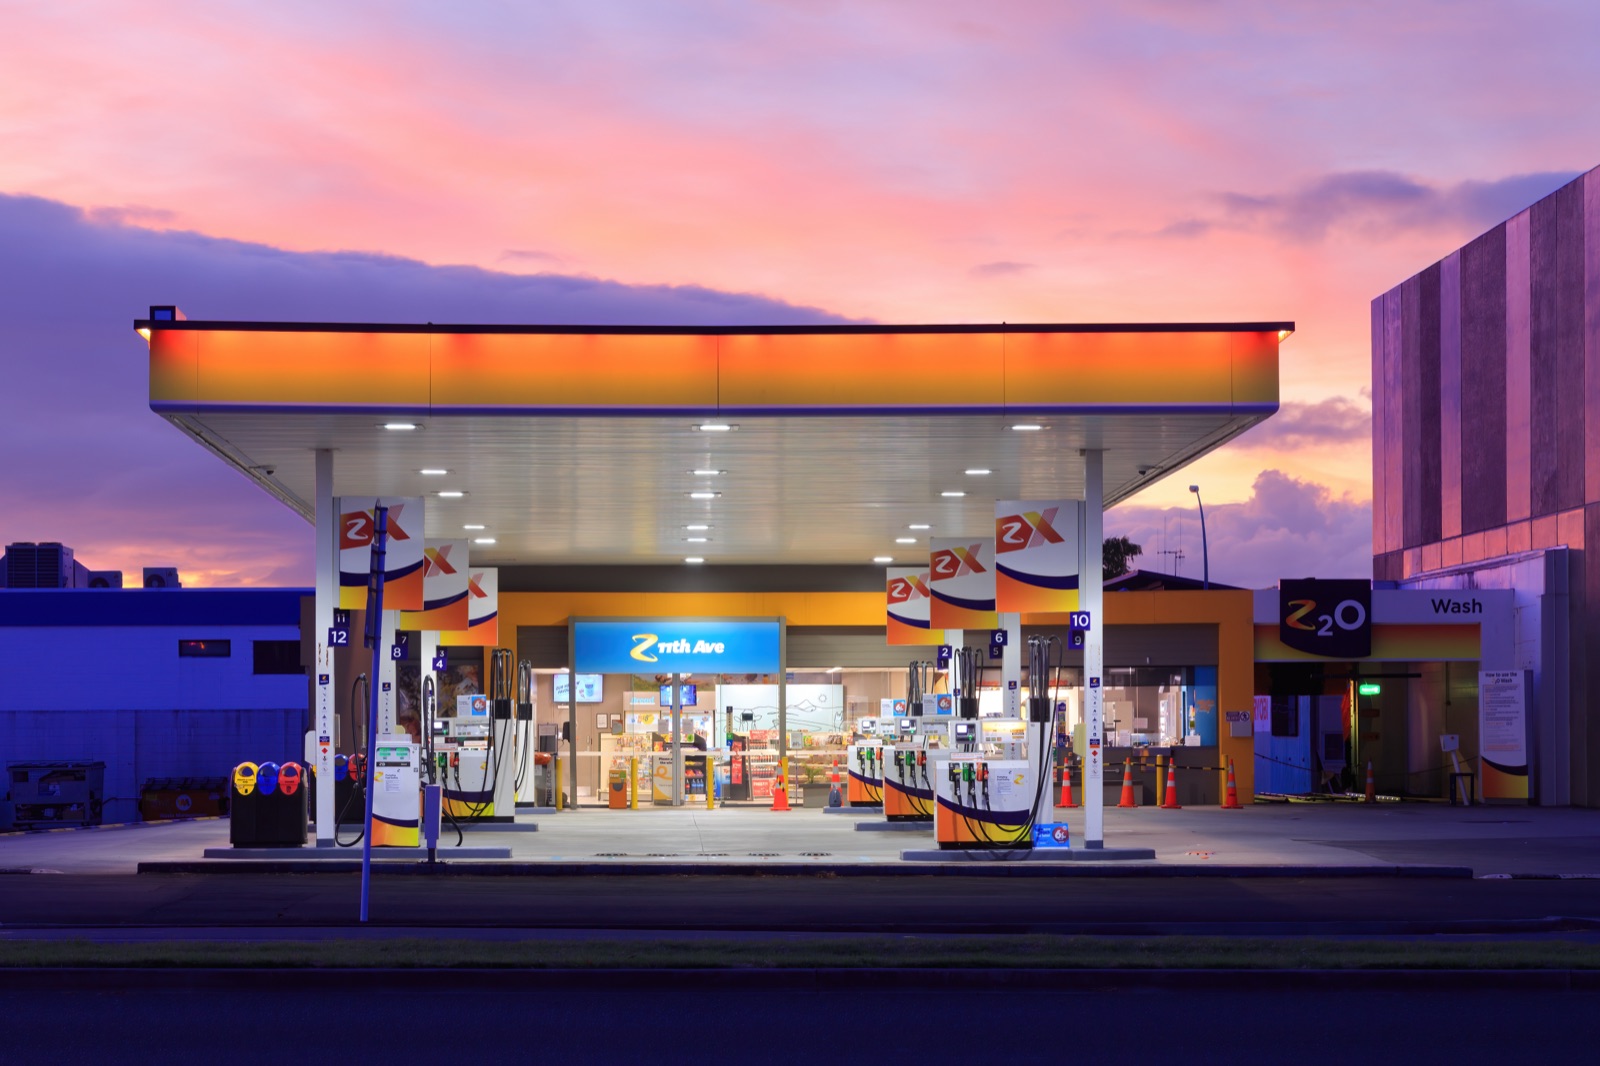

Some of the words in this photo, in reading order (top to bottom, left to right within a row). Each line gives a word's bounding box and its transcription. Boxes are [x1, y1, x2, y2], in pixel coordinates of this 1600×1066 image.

[1431, 598, 1483, 614] Wash
[336, 613, 346, 623] 11
[1072, 614, 1089, 627] 10
[331, 630, 347, 644] 12
[401, 635, 407, 644] 7
[995, 632, 1003, 643] 6
[1074, 635, 1082, 646] 9
[692, 639, 725, 654] Ave
[941, 647, 949, 657] 2
[993, 647, 999, 656] 5
[393, 647, 402, 658] 8
[439, 650, 445, 658] 3
[435, 659, 444, 669] 4
